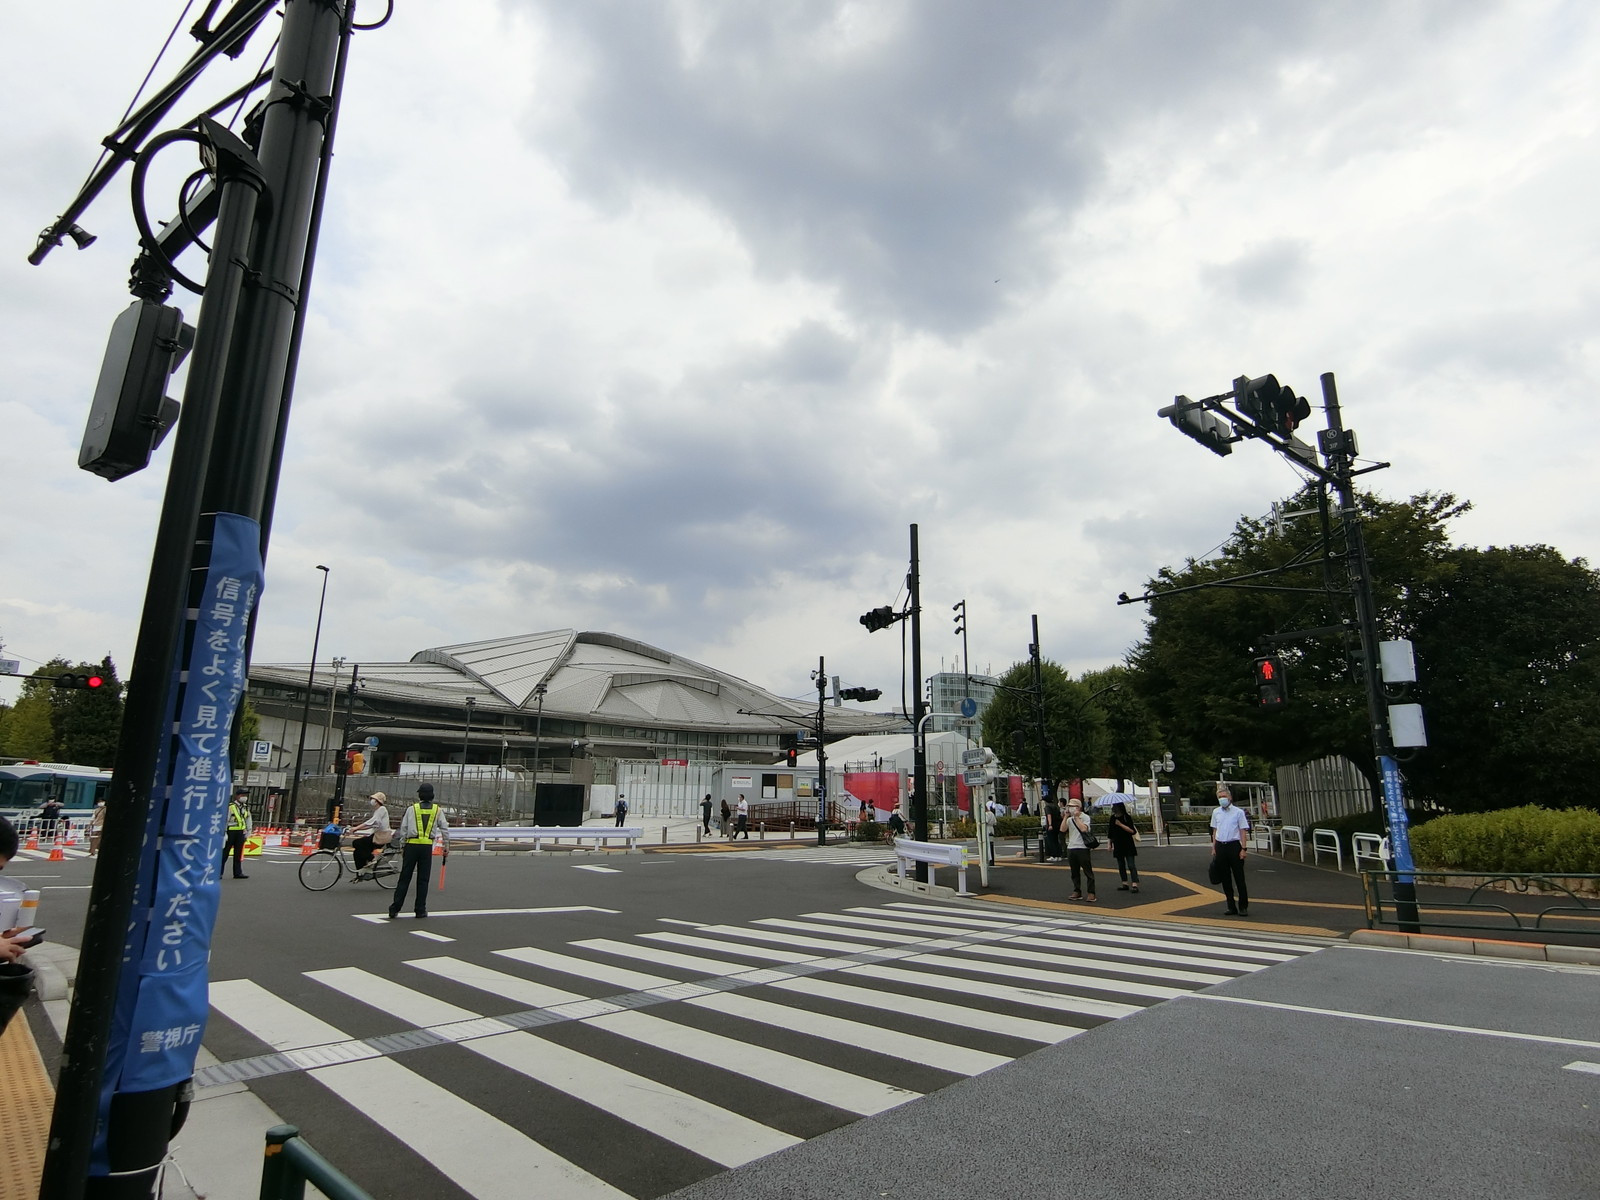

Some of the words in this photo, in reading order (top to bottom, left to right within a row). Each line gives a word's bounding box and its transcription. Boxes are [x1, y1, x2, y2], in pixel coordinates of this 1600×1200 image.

[157, 576, 241, 971] 信号をよく見て進行してください
[139, 1023, 201, 1054] 警視庁
